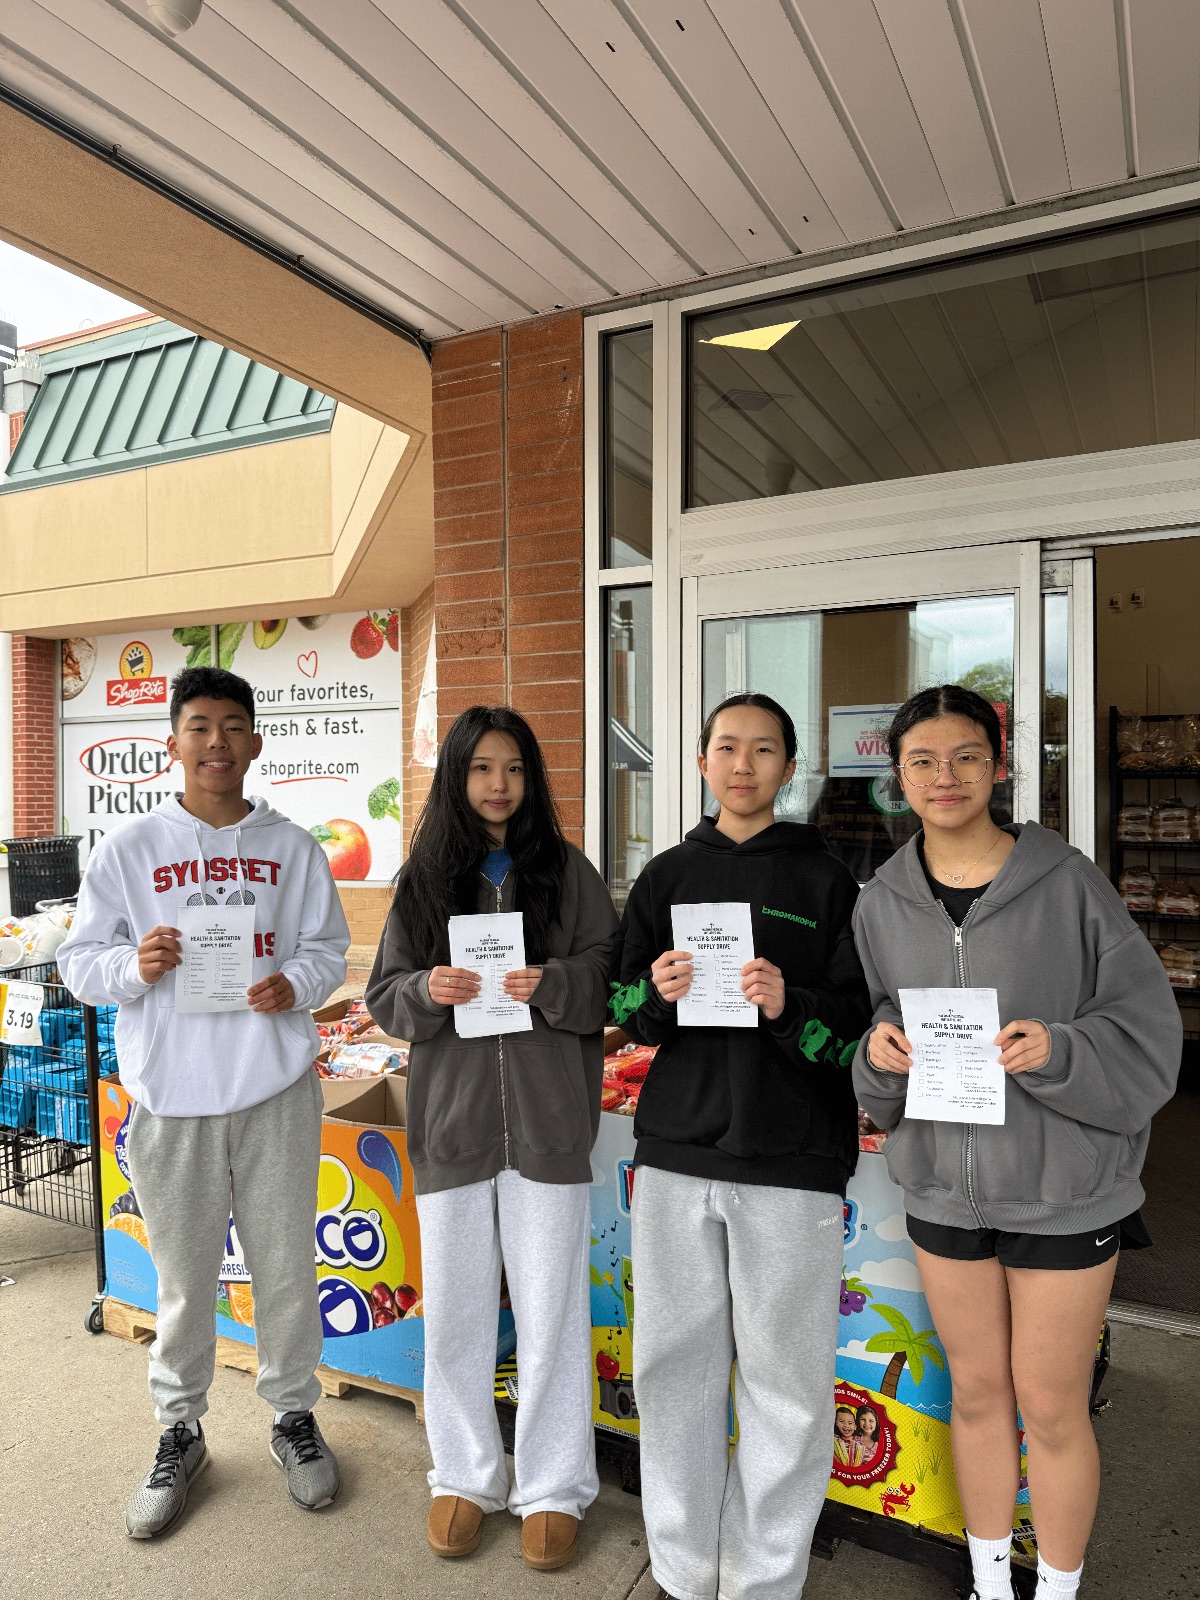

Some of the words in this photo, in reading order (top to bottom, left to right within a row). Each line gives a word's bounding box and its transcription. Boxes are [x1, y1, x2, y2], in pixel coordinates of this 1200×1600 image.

[109, 680, 165, 706] ShopRite
[290, 681, 374, 701] favorites,
[256, 719, 299, 737] fresh
[305, 718, 318, 735] &
[324, 716, 364, 735] fast.
[260, 759, 360, 778] shoprite.com
[88, 782, 172, 814] Picku
[153, 857, 281, 893] SYOSSET
[761, 904, 817, 929] CHROMAKOPIA
[6, 1009, 33, 1029] 3.19
[934, 1031, 955, 1039] SUPPLY
[846, 1390, 869, 1405] SMILE!
[837, 1471, 852, 1480] FOR
[852, 1472, 871, 1481] YOUR
[871, 1452, 891, 1477] FREEZER
[883, 1427, 892, 1452] TODAY!
